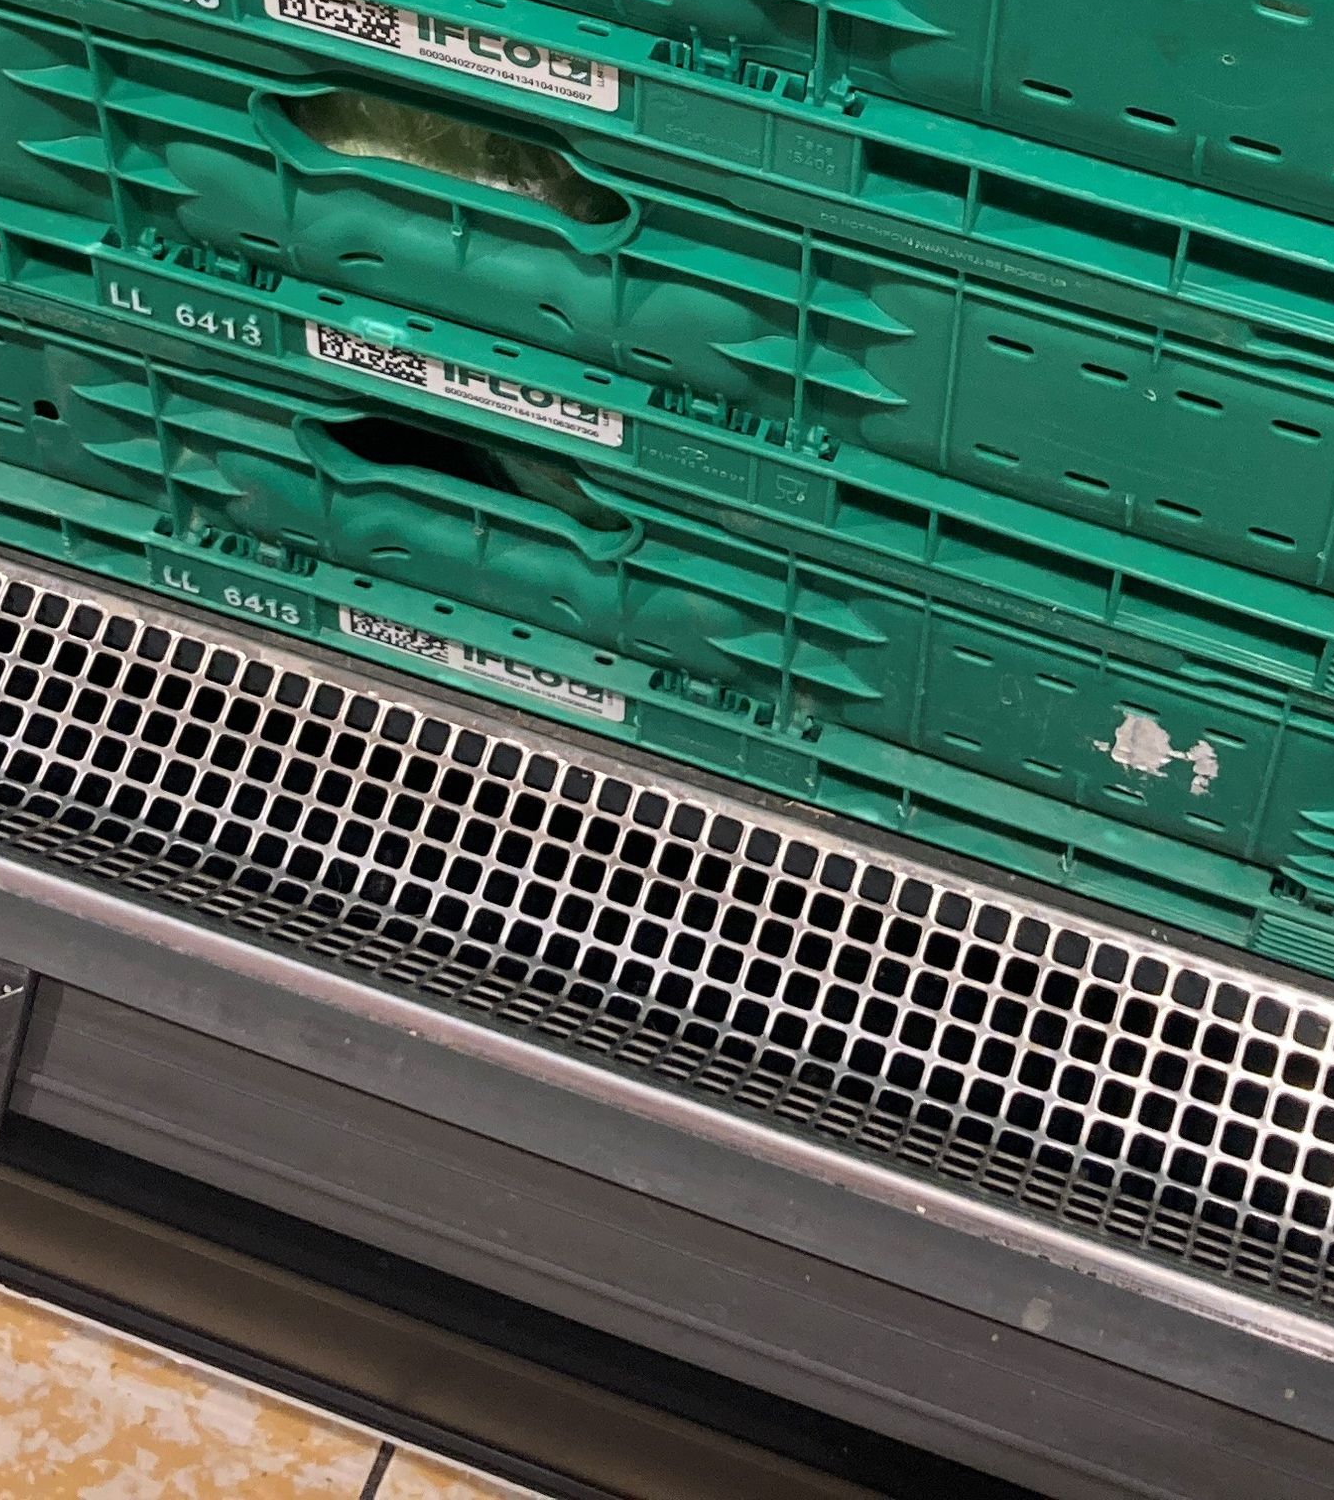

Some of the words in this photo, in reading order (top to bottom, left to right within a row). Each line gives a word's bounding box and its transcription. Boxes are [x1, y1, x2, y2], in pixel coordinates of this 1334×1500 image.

[416, 12, 542, 69] IFCO
[109, 281, 153, 316] LL
[175, 303, 262, 348] 6413
[163, 564, 200, 594] LL
[223, 585, 302, 625] 6413
